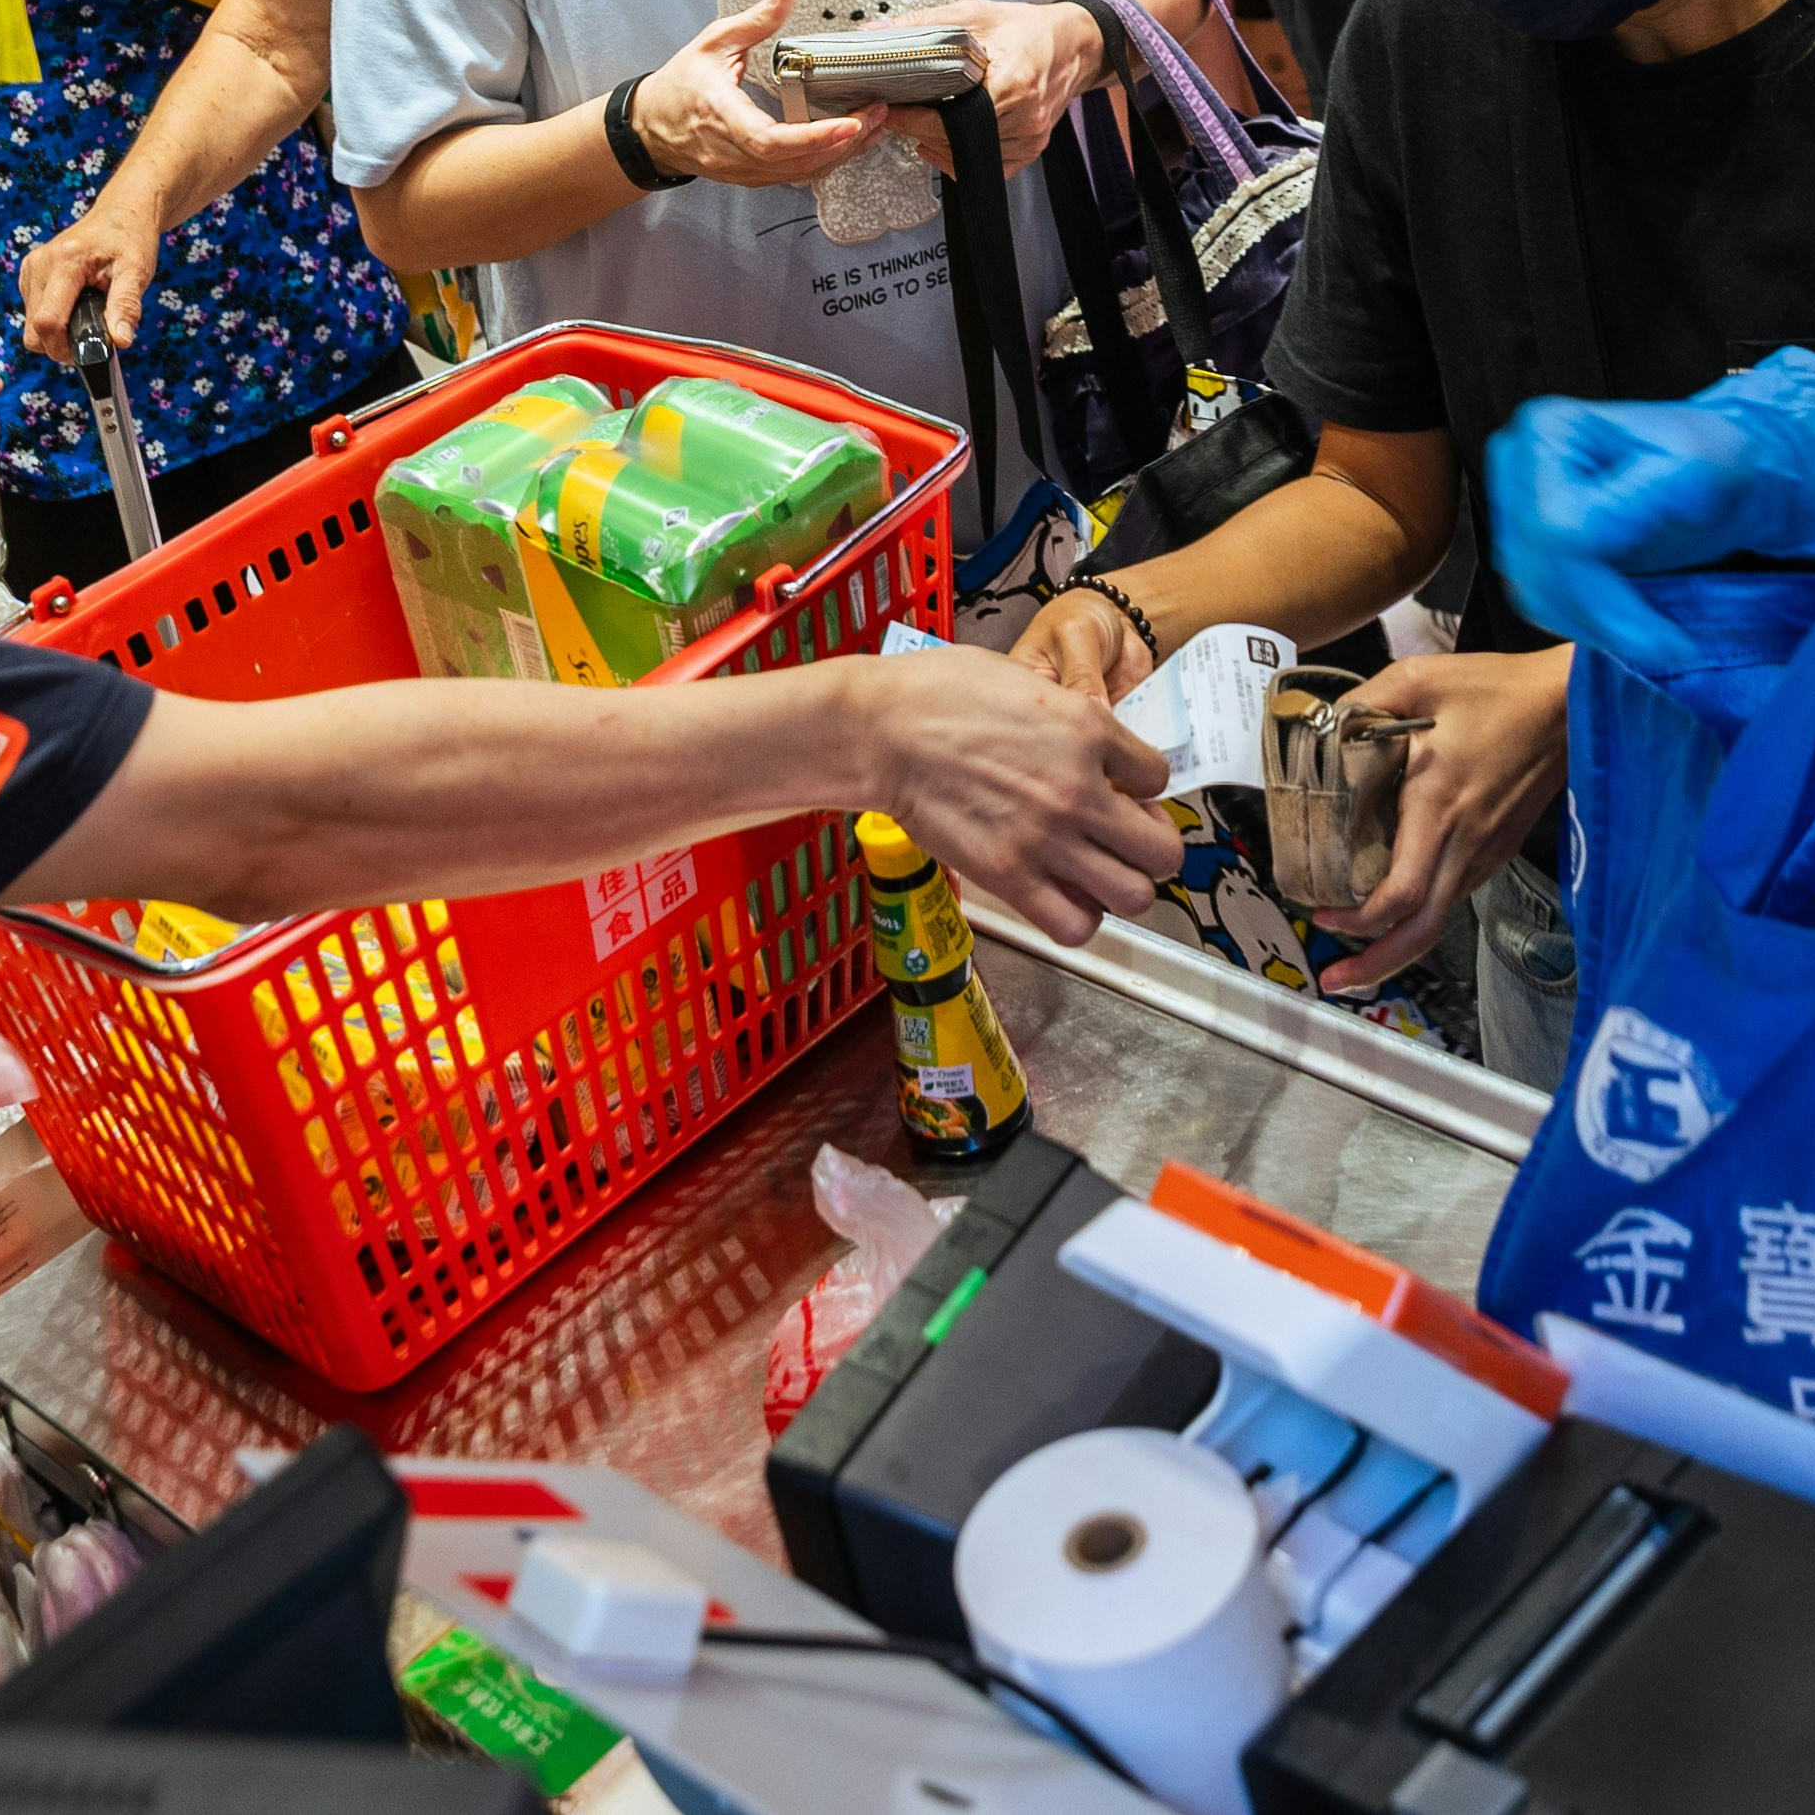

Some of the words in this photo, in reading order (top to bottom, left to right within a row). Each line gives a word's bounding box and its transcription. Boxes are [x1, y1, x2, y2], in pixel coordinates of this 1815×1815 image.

[812, 274, 838, 295] HE
[844, 268, 862, 286] IS
[868, 242, 949, 280] THINKING
[822, 287, 888, 317] GOING
[893, 278, 920, 299] TO
[606, 869, 688, 946] 食品
